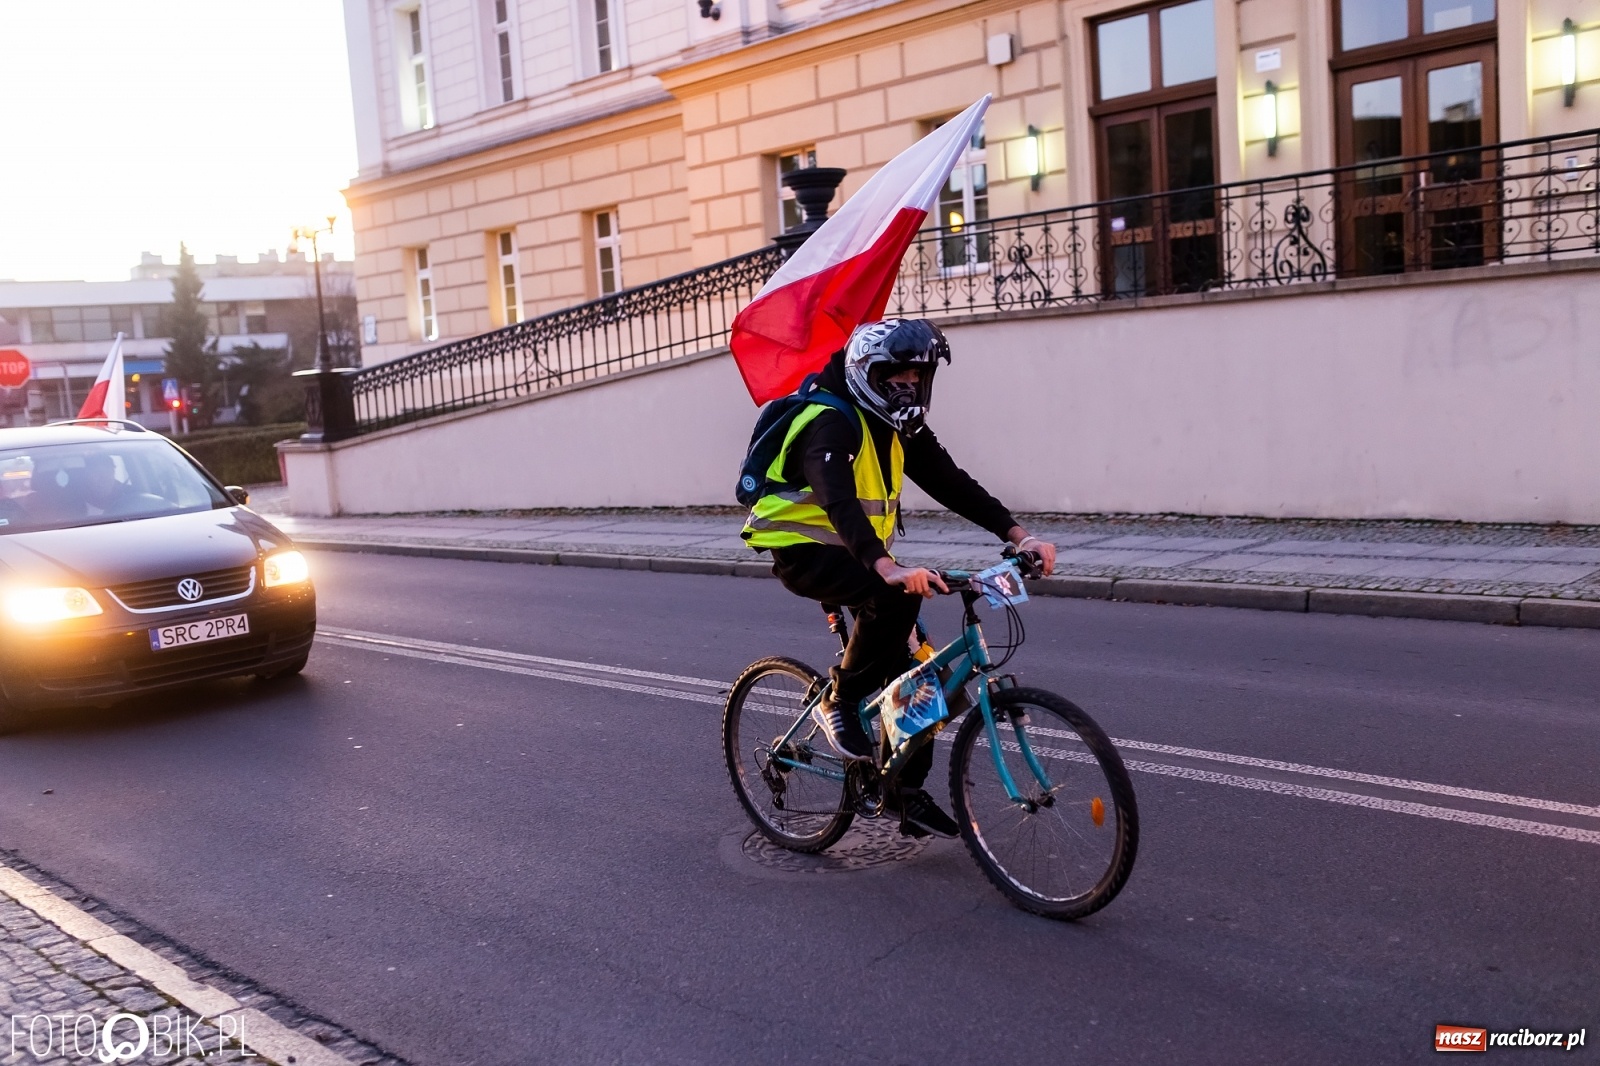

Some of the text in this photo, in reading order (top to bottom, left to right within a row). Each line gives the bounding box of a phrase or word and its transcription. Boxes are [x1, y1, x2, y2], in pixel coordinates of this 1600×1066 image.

[0, 361, 27, 375] TOP
[162, 615, 247, 645] SRC 2PR4
